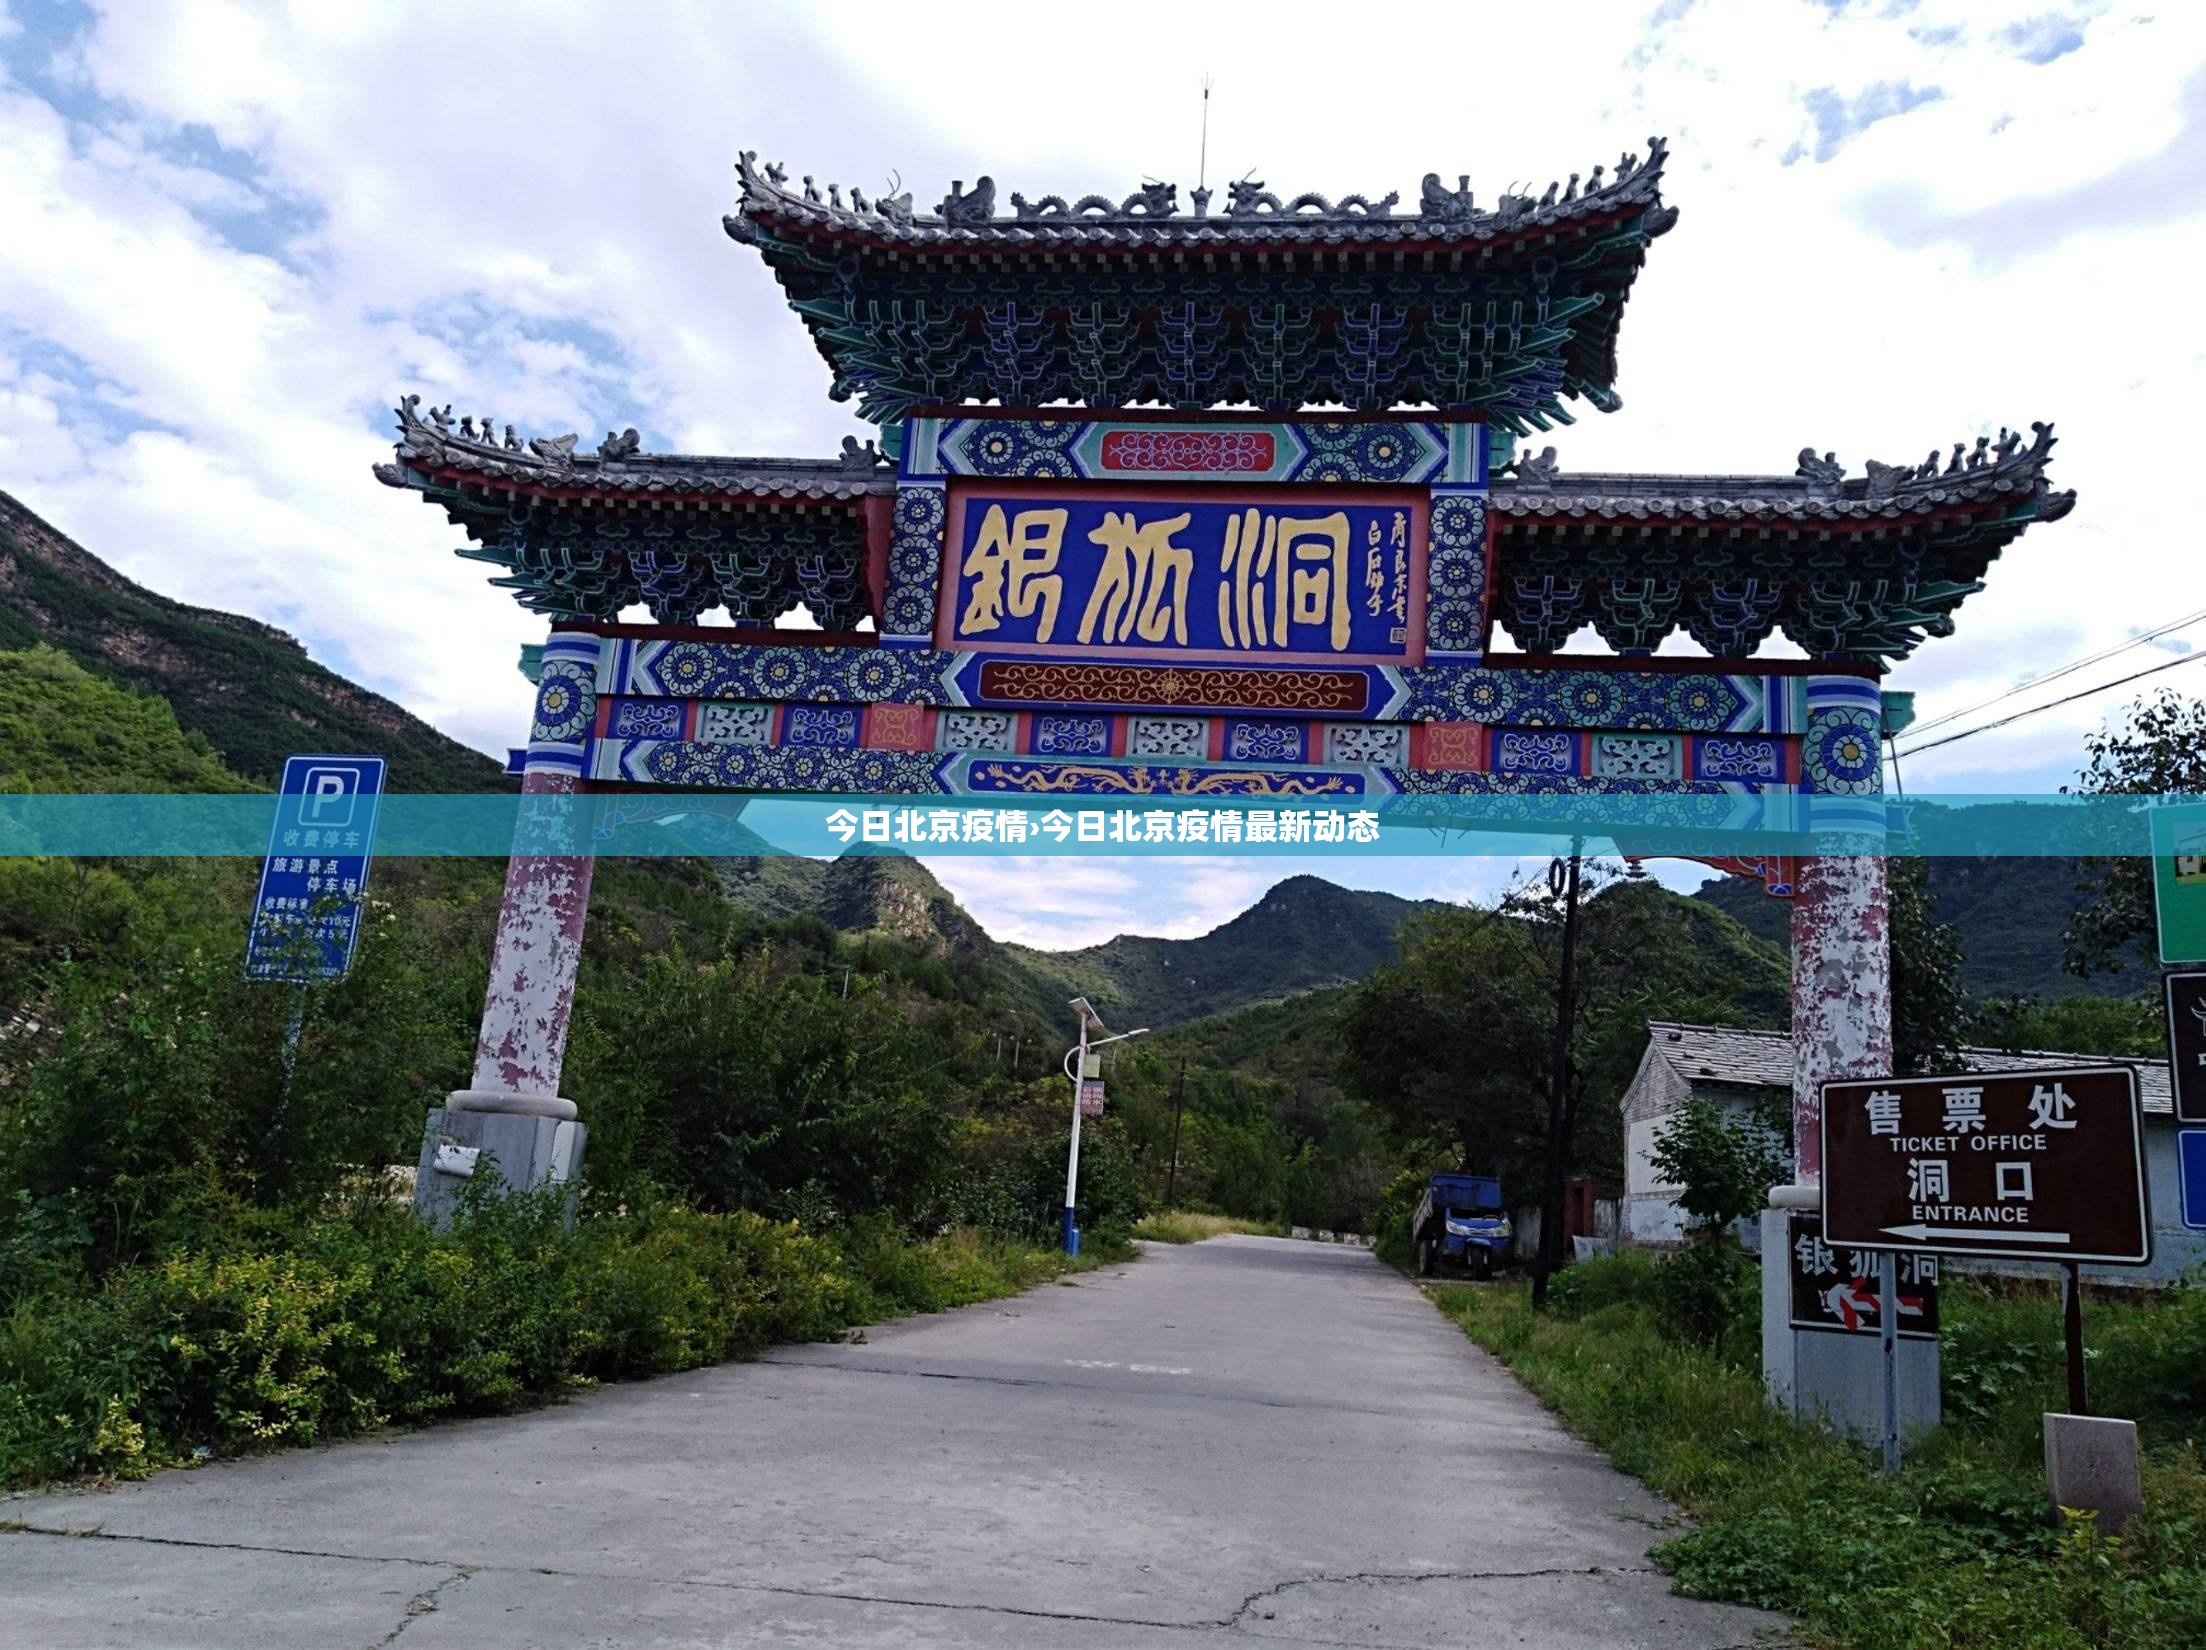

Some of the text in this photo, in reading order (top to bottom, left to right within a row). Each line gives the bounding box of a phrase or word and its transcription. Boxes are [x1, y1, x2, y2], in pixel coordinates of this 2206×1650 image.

[311, 775, 345, 818] P
[284, 829, 360, 849] 收费停车
[272, 857, 338, 875] 旅游景点
[307, 877, 356, 896] 停车场
[1864, 1083, 2078, 1135] 售票处
[1889, 1134, 2047, 1152] TICKET OFFICE
[1907, 1157, 2034, 1203] 洞口
[1912, 1205, 2029, 1223] ENTRANCE
